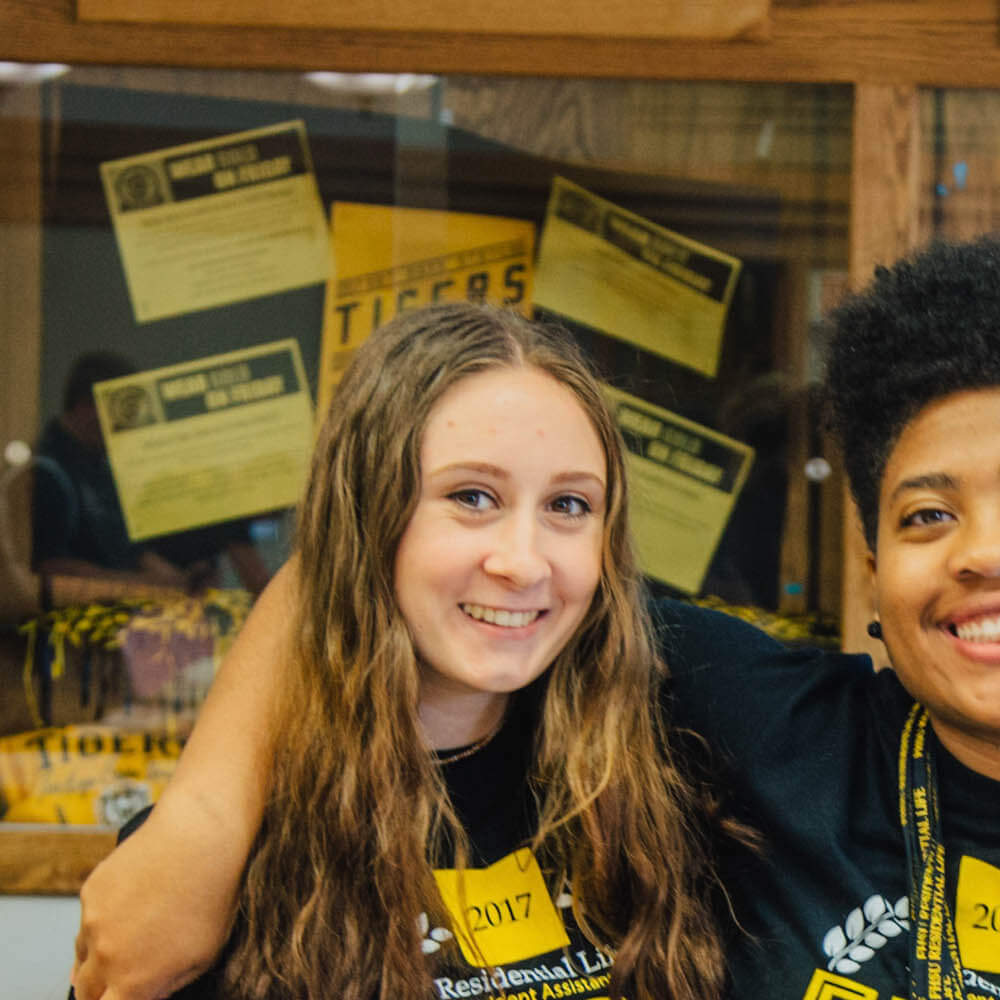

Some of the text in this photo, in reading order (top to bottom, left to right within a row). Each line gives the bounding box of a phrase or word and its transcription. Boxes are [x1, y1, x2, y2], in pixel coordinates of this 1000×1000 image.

[912, 786, 929, 816] LIFE
[467, 891, 532, 932] 2017
[929, 876, 944, 960] RESIDENTIAL
[435, 956, 577, 1000] Residential
[927, 963, 942, 999] FHSU
